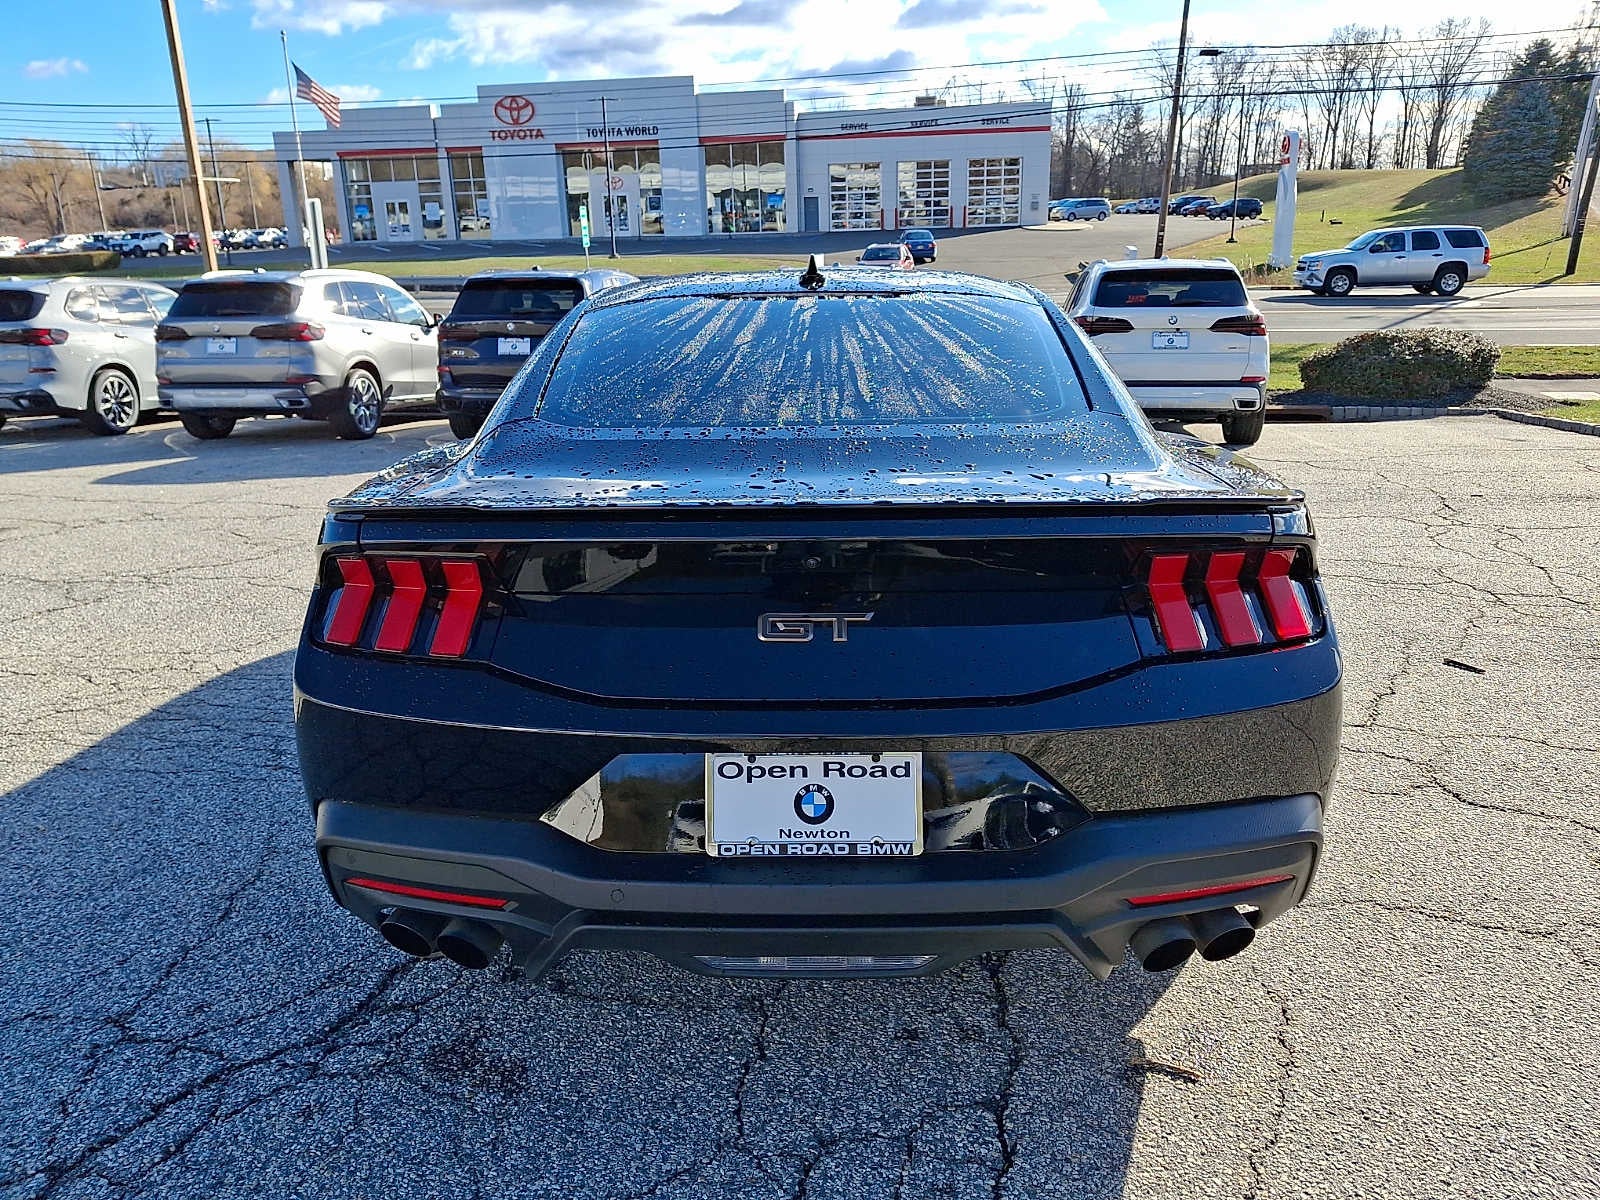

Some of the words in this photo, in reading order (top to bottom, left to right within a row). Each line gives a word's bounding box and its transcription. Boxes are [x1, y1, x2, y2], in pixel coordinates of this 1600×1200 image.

[623, 125, 658, 137] WORLD
[840, 122, 869, 131] SERVICE
[489, 128, 545, 141] TOYOTA
[757, 611, 875, 642] GT
[717, 761, 808, 783] Open
[822, 761, 911, 779] Road
[799, 784, 830, 797] BMW
[779, 828, 850, 839] Newton
[720, 843, 780, 856] OPEN
[787, 843, 850, 856] ROAD
[856, 843, 911, 856] BMW
